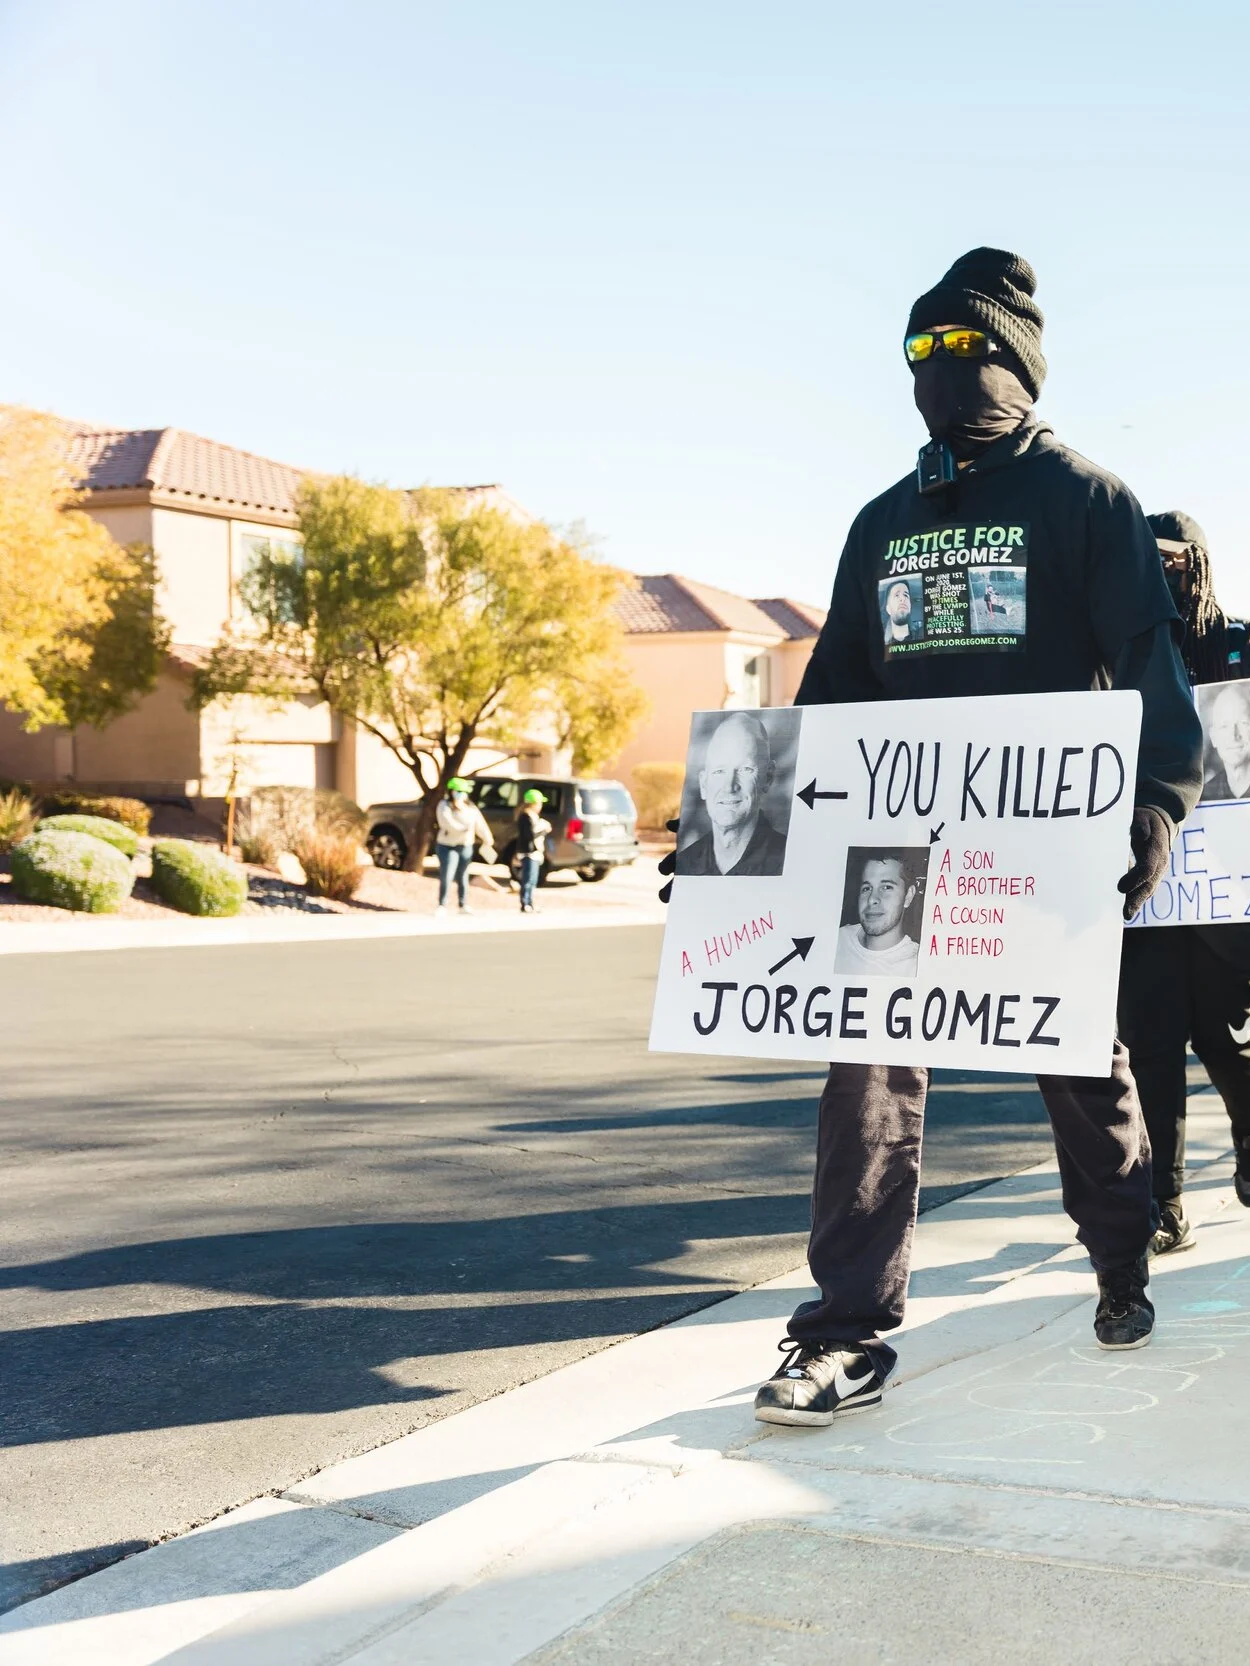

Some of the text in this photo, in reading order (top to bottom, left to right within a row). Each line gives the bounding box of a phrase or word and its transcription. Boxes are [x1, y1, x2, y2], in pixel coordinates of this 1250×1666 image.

[884, 526, 1024, 560] JUSTICE FOR
[889, 547, 1013, 575] JORGE GOMEZ
[924, 583, 967, 595] JORGE GOMEZ
[930, 590, 960, 600] WAS SHOT
[928, 615, 964, 623] PEACEFULLY
[888, 637, 1017, 654] WWW.JUSTICEFORJORGEGOMEZ.COM
[857, 738, 1126, 822] YOU KILLED
[940, 849, 994, 873] A SON
[935, 875, 1036, 897] A BROTHER
[932, 905, 1005, 926] A COUSIN
[680, 911, 775, 977] A HUMAN
[929, 935, 1005, 958] A FRIEND
[693, 981, 1062, 1047] JORGE GOMEZ
